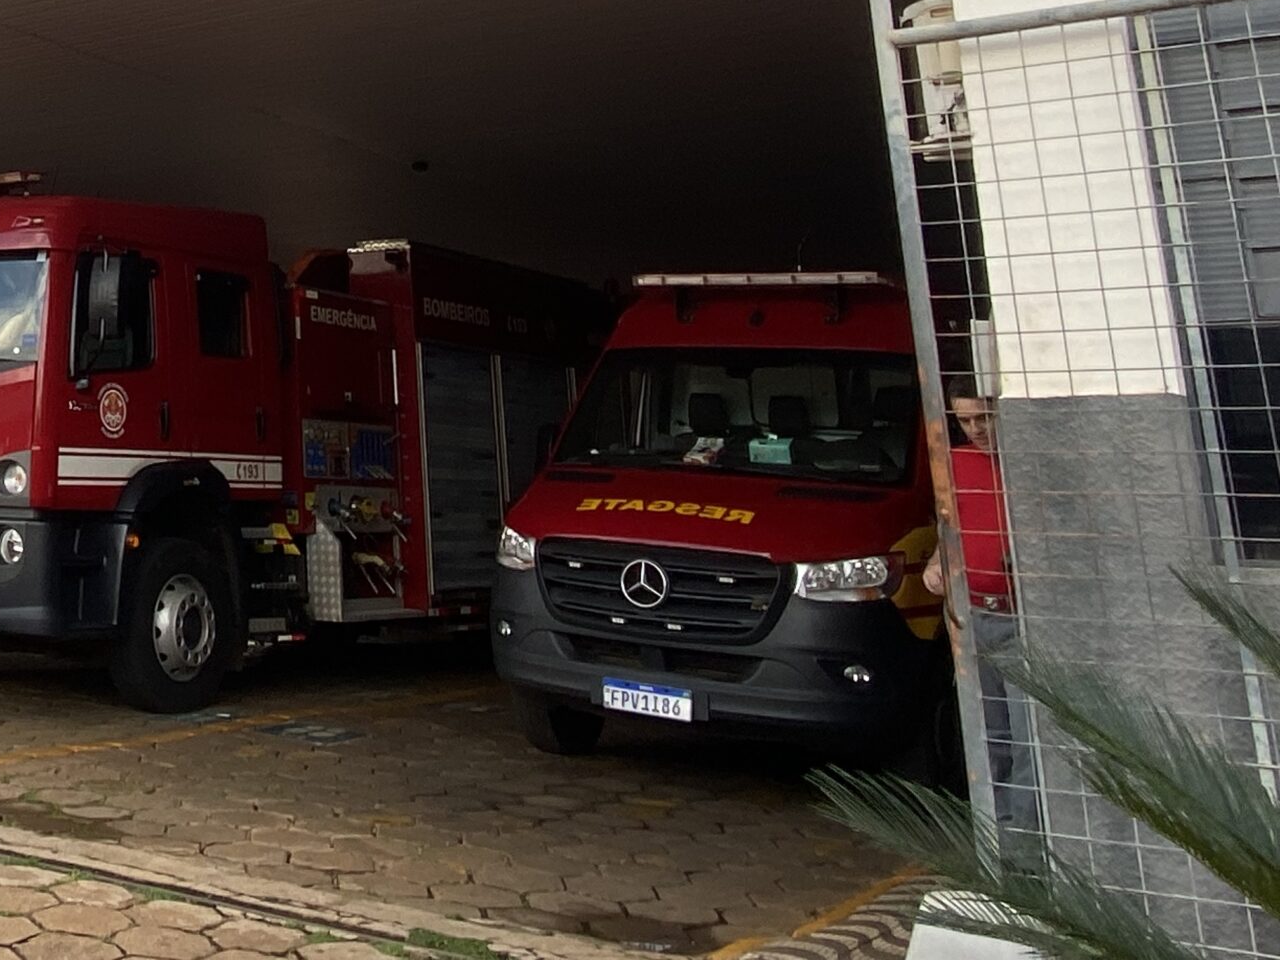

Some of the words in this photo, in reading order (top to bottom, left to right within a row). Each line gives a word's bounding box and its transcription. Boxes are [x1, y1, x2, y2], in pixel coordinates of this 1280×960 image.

[310, 304, 378, 333] EMERGÊNCIA
[423, 296, 491, 328] BOMBEIROS
[242, 463, 259, 480] 193
[610, 689, 682, 717] FPV1I86
